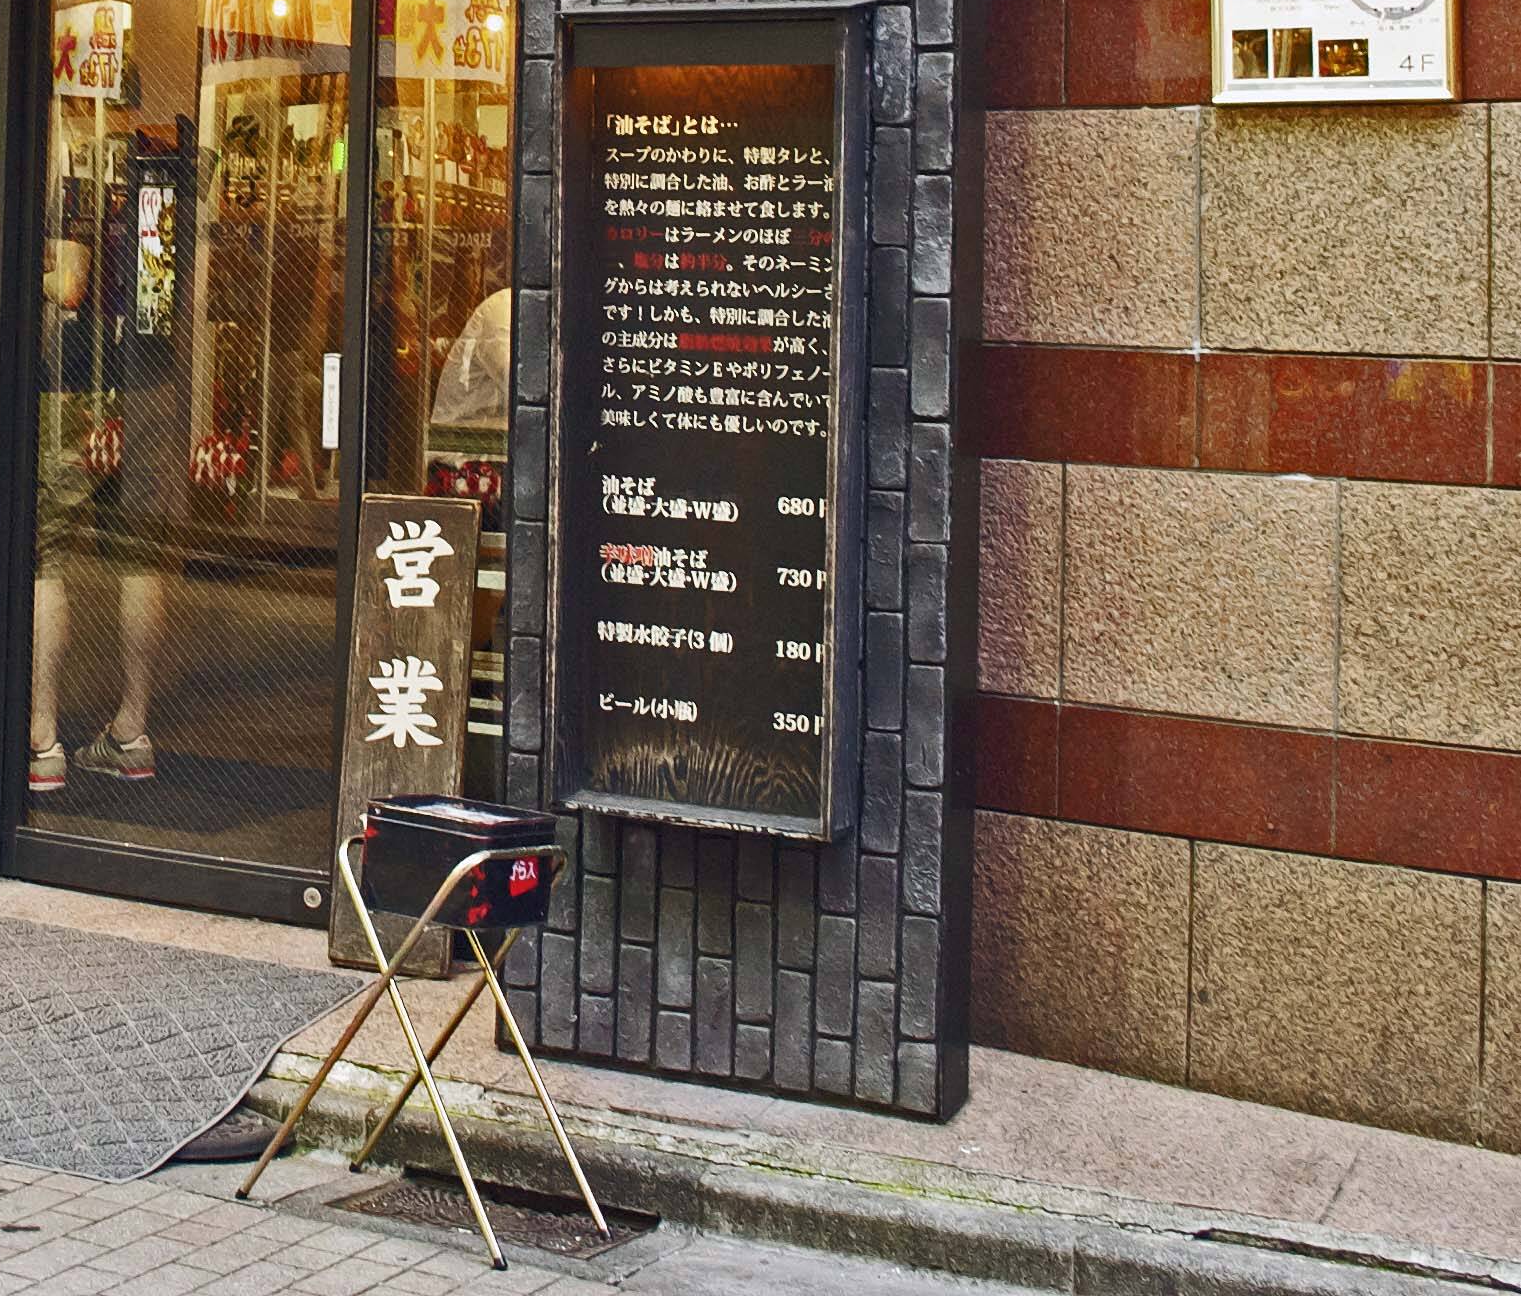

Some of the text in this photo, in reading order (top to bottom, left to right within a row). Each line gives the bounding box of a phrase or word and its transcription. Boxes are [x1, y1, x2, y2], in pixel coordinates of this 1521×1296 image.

[1399, 53, 1434, 73] 4F
[602, 474, 656, 496] 油そば
[365, 519, 456, 749] 営業
